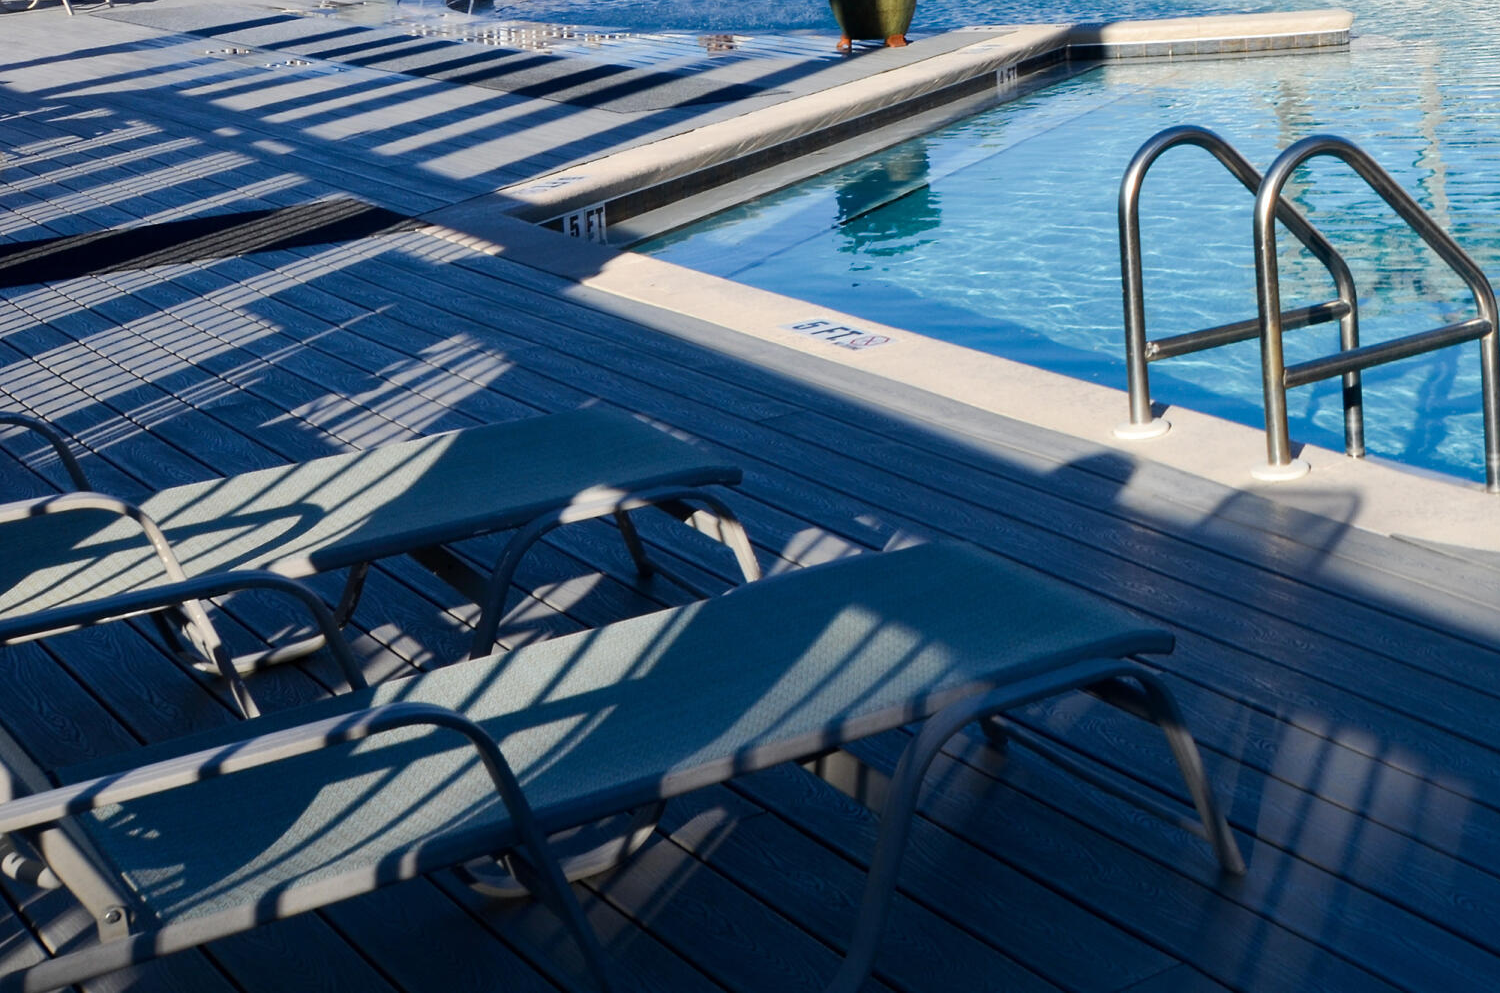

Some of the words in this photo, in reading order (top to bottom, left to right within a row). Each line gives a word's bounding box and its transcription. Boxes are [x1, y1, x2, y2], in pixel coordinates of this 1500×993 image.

[569, 214, 580, 237] 5
[586, 206, 604, 233] FT
[792, 321, 830, 331] 5
